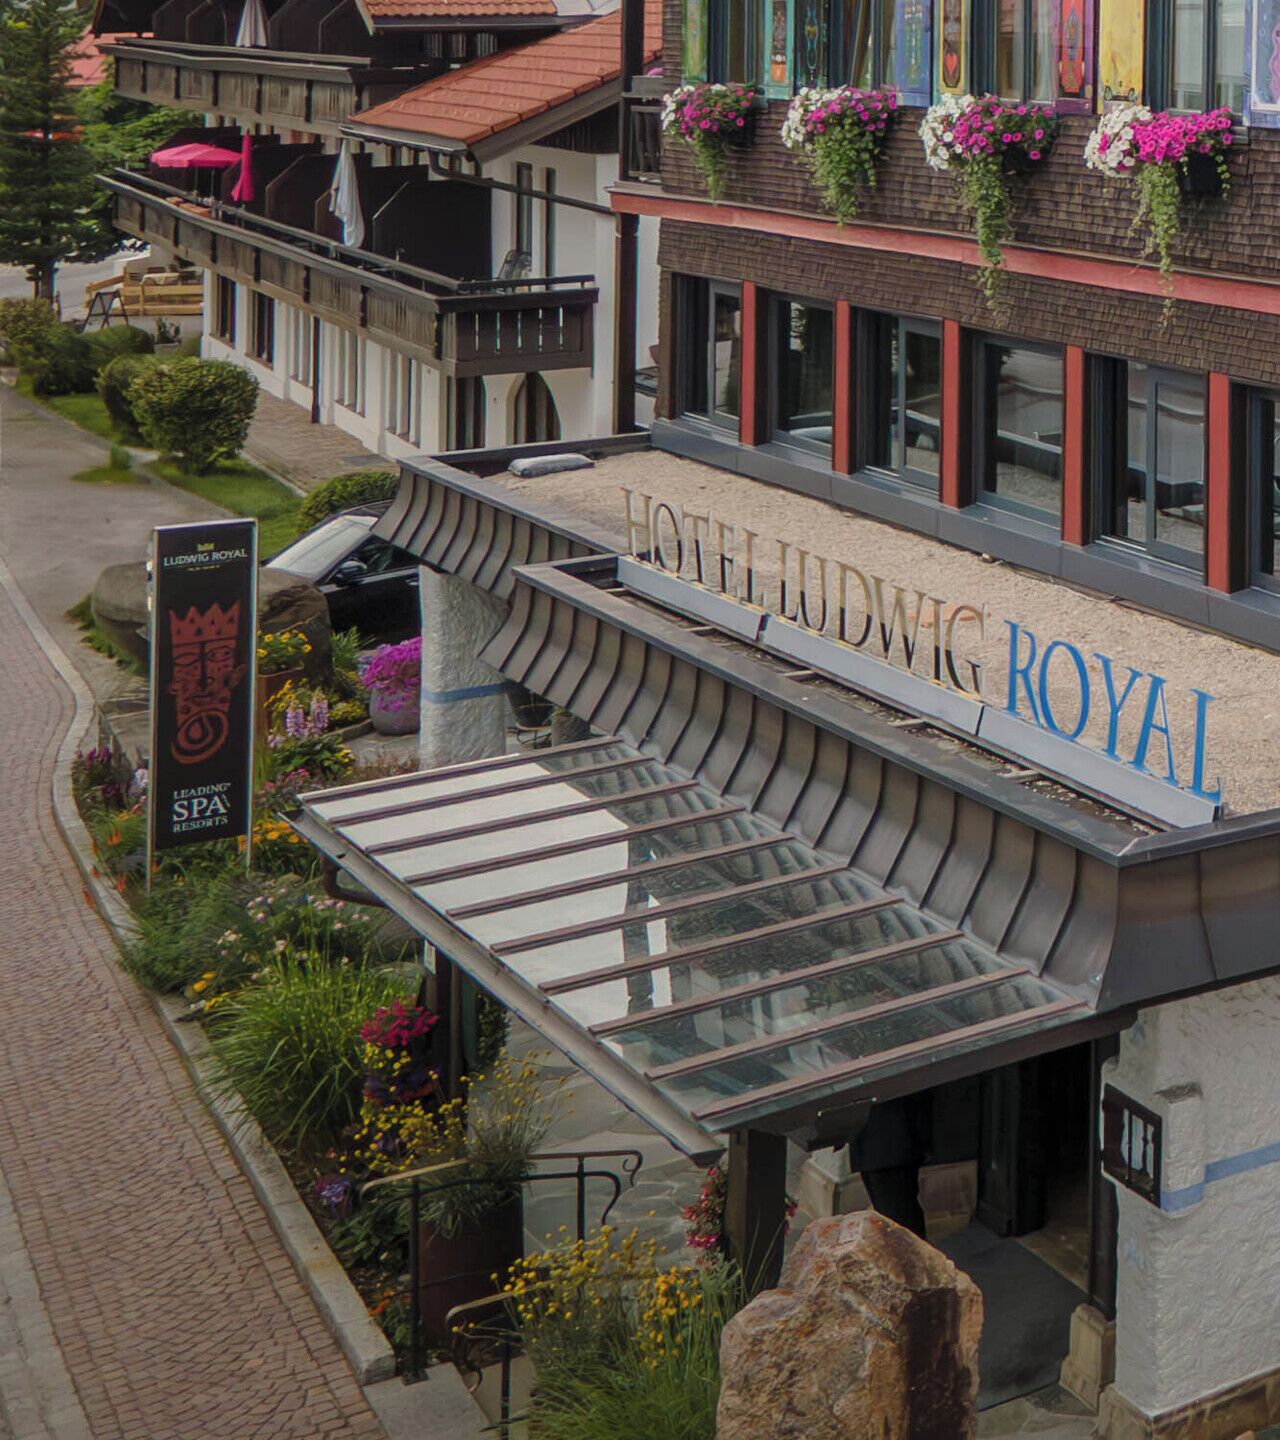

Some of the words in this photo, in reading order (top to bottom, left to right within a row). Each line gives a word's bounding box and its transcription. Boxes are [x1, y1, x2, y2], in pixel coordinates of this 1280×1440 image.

[163, 553, 210, 567] LUDWIG
[211, 548, 249, 561] ROYAL
[619, 486, 768, 613] HOTEL
[776, 539, 988, 698] LUDWIG
[1003, 619, 1222, 805] ROYAL
[174, 782, 231, 799] LEADING
[172, 795, 228, 822] SPA
[172, 815, 229, 834] RESORTS
